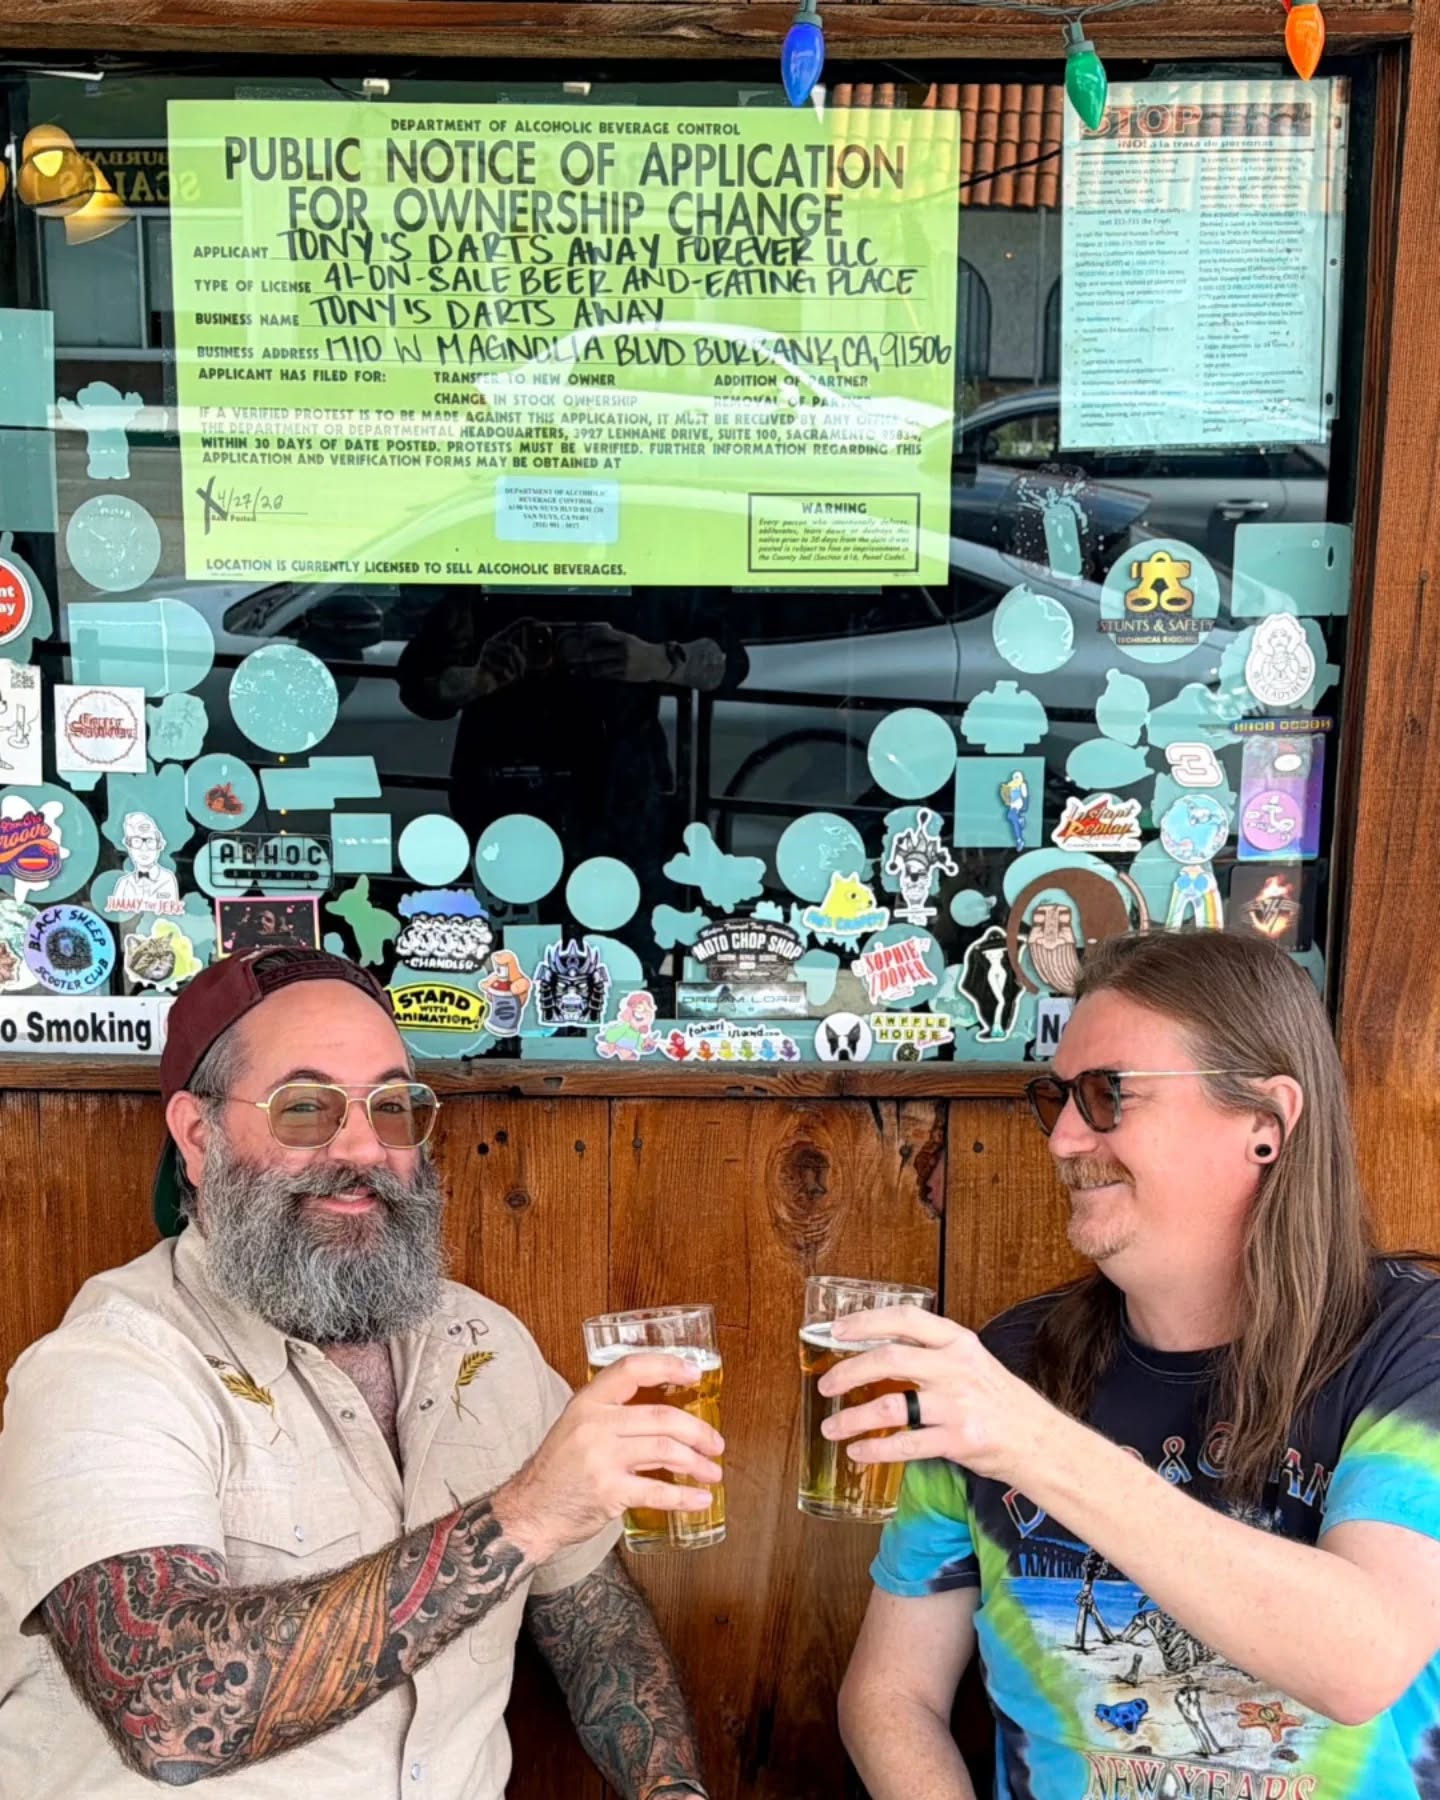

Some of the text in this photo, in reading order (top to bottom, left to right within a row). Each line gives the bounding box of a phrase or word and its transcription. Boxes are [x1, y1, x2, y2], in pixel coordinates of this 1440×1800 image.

[391, 119, 740, 136] DEPARTMENT OF ALCOHOLIC BEVERAGE CONTROL
[224, 136, 904, 190] PUBLIC NOTICE OF APPLICATION
[288, 185, 844, 238] FOR OWNERSHIP CHANGE
[194, 246, 269, 260] APPLICANT
[276, 228, 413, 265] TONY'S
[428, 233, 554, 265] DARTS
[568, 233, 660, 267] AWAY
[676, 235, 814, 267] FOREVER
[194, 279, 312, 294] TYPE OF LICENSE
[828, 268, 918, 296] PLACE
[195, 312, 300, 326] BUSINESS NAME
[309, 298, 664, 330] TONY'S DARTS AWAY
[197, 346, 319, 360] BUSINESS ADDRESS
[394, 334, 424, 364] W
[436, 333, 605, 366] MAGNOLIA
[614, 334, 686, 367] BLVD
[198, 368, 386, 382] APPLICANT HAS FILED FOR:
[508, 373, 526, 385] TO
[532, 373, 560, 385] NEW
[568, 374, 616, 386] OWNER
[714, 374, 776, 386] ADDITION
[434, 393, 638, 408] CHANGE IN STOCK OWNERSHIP
[200, 407, 208, 418] IF
[216, 408, 226, 418] A
[232, 408, 290, 420] VERIFIED
[294, 408, 354, 420] PROTEST
[360, 409, 371, 421] IS
[375, 410, 395, 421] TO
[400, 410, 416, 422] BE
[422, 411, 459, 422] MADE
[466, 412, 522, 423] AGAINST
[528, 412, 555, 424] THIS
[560, 412, 652, 426] APPLICATION,
[658, 414, 670, 425] IT
[714, 414, 729, 425] BE
[734, 414, 795, 426] RECEIVED
[801, 414, 818, 426] BY
[824, 414, 850, 426] ANY
[200, 422, 874, 442] THE DEPARTMENT OR DEPARTMENTAL HEADQUARTERS, 3927 LENNANE DRIVE, SUITE 100, SACRAMENTO
[201, 438, 922, 456] WITHIN 30 DAYS OF DATE POSTED. PROTESTS MUST BE VERIFIED. FURTHER INFORMATION REGARDING THIS
[202, 452, 622, 469] APPLICATION AND VERIFICATION FORMS MAY BE OBTAINED AT
[802, 502, 868, 514] WARNING
[206, 559, 627, 576] LOCATION IS CURRENTLY LICENSED TO SELL ALCOHOLIC BEVERAGES.
[1153, 619, 1167, 633] &
[28, 909, 107, 952] BLACK SHEEP
[692, 932, 804, 960] MOTO CHOP SHOP
[34, 958, 109, 990] SCOOTER CLUB
[26, 1010, 152, 1050] Smoking
[1082, 1752, 1166, 1799] NEW
